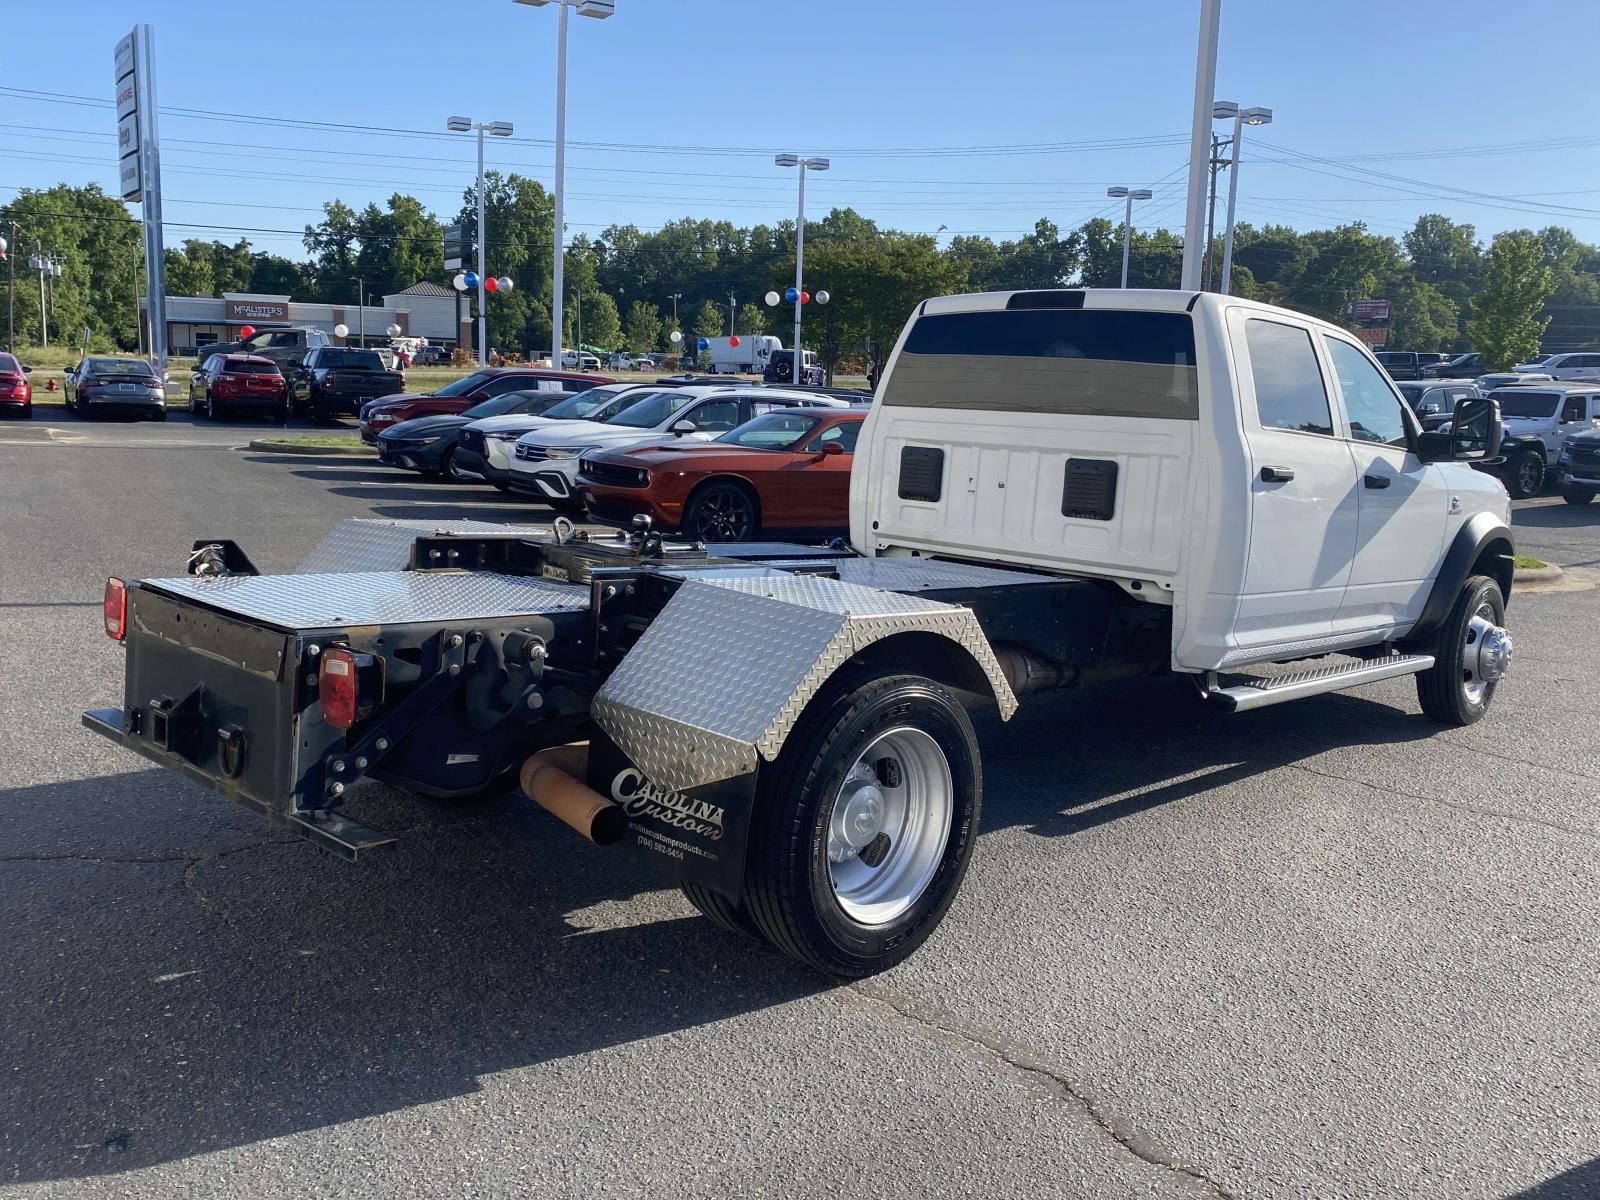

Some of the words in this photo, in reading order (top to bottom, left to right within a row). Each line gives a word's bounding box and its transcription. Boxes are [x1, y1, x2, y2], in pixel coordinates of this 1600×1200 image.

[611, 767, 725, 826] CAROLINA
[623, 797, 724, 841] Custom
[627, 821, 719, 862] arolinacustomproducts.com
[637, 834, 654, 850] (704)
